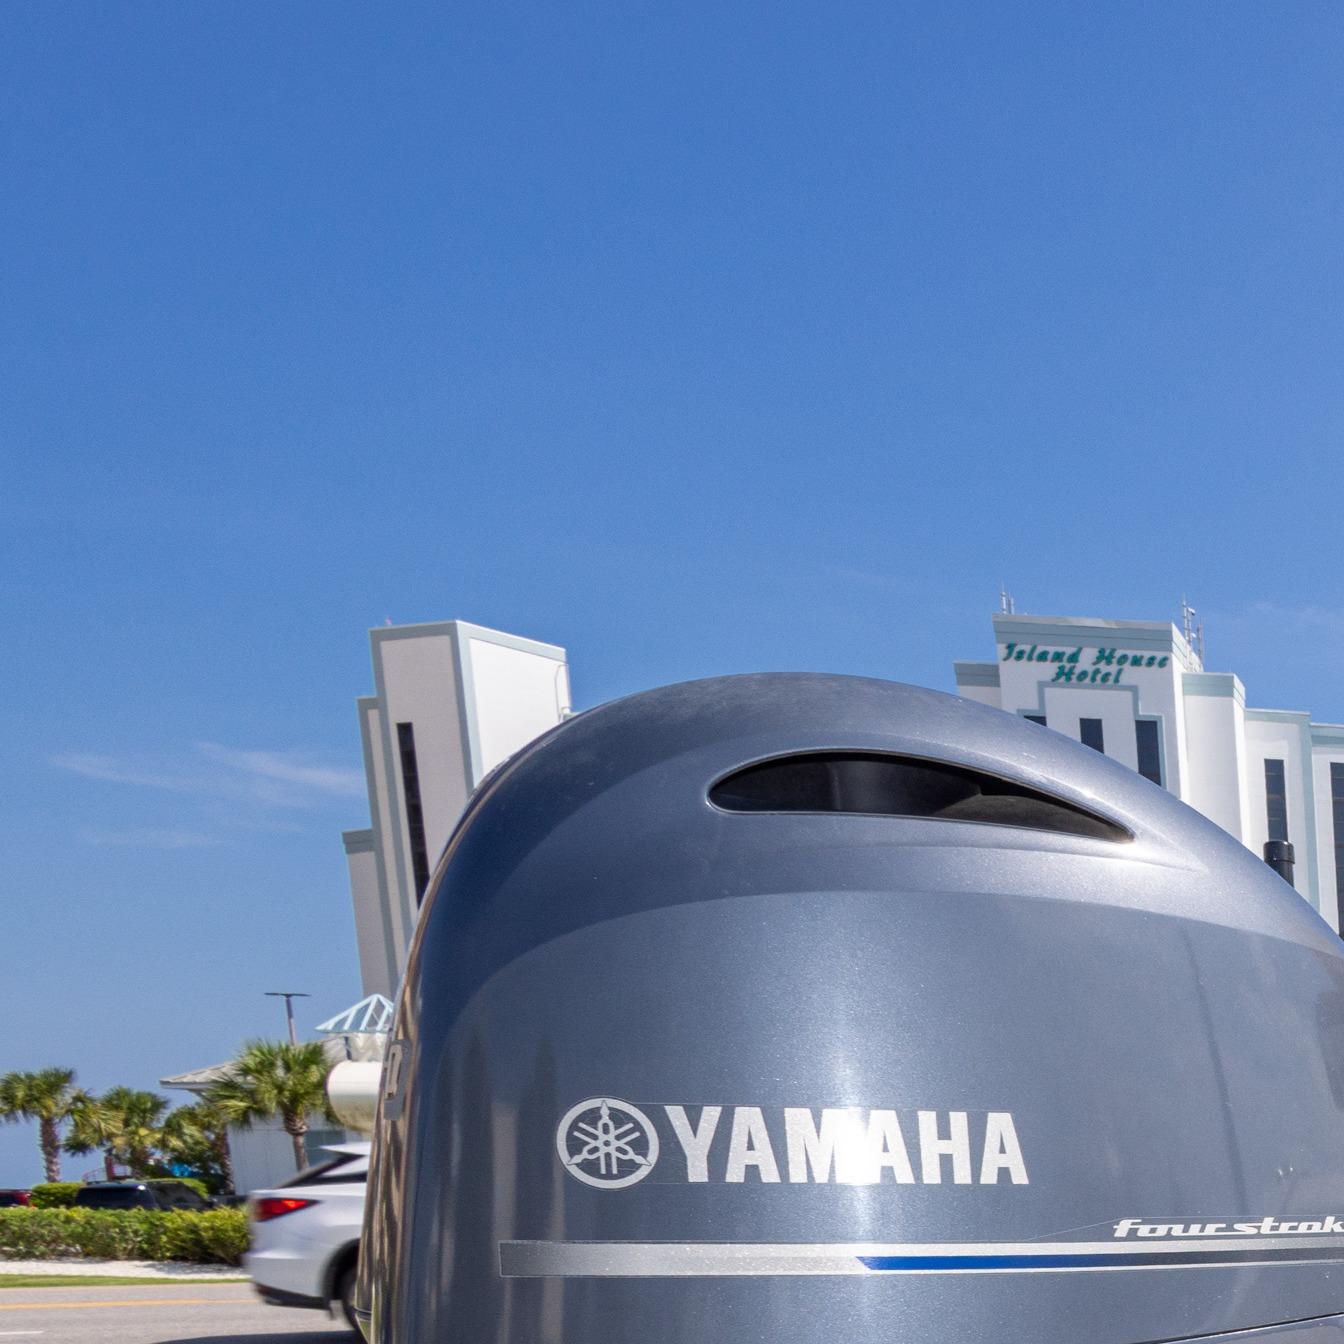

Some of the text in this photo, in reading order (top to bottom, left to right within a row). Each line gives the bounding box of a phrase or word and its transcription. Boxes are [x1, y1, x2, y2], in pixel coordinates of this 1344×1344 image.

[1003, 642, 1170, 668] Island House
[1052, 665, 1124, 684] Hotel
[664, 1105, 1030, 1186] YAMAHA
